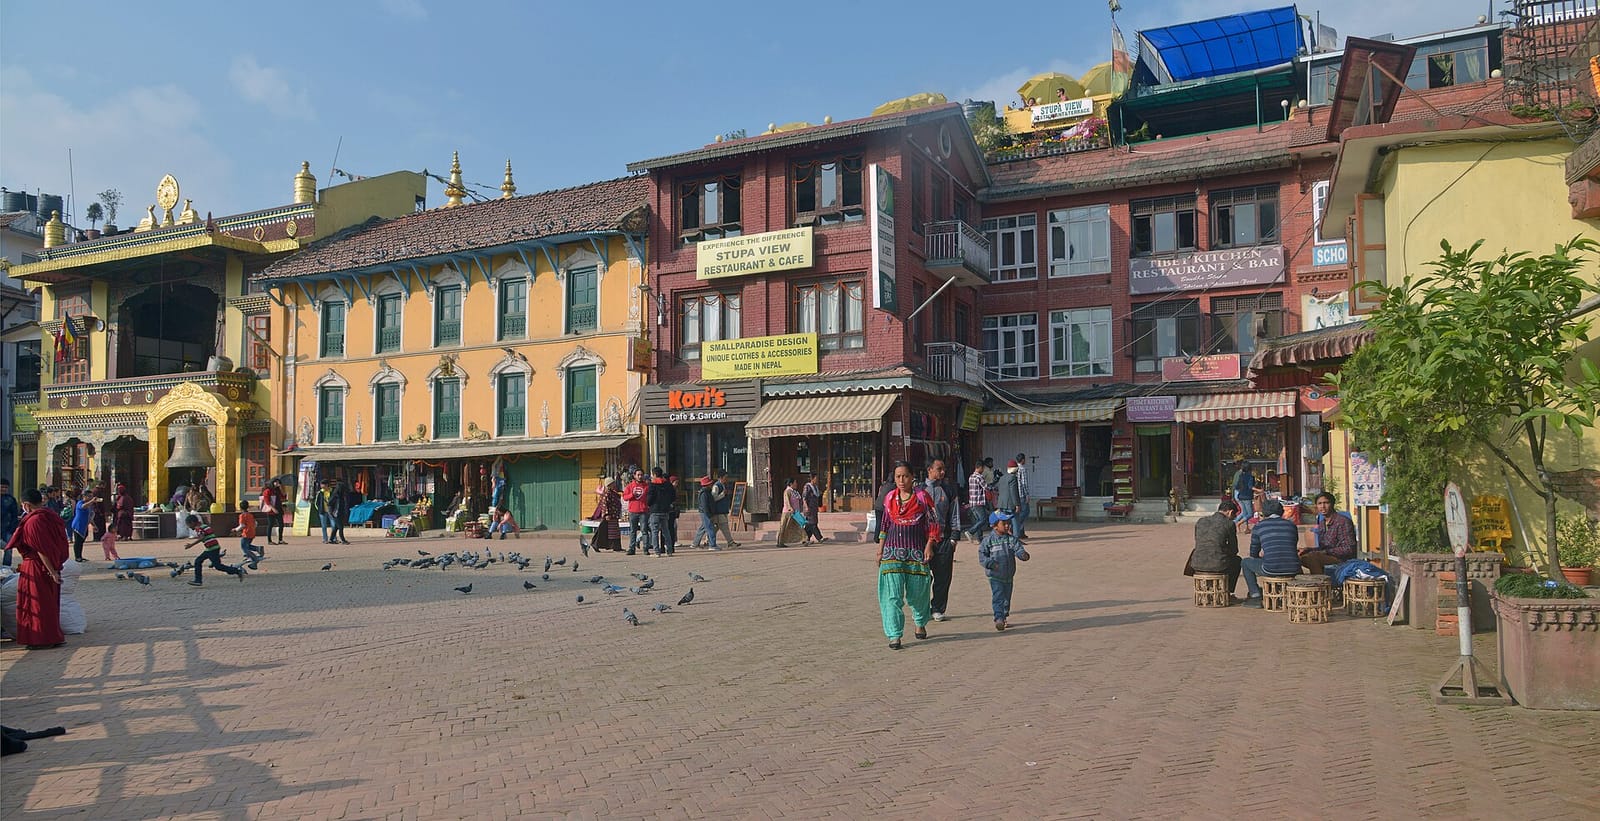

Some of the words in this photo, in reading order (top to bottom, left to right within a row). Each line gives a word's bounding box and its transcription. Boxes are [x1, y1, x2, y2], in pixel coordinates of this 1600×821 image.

[1040, 104, 1062, 115] STUPA
[1064, 101, 1083, 111] VIEW
[702, 239, 745, 251] EXPERIENCE
[747, 237, 761, 245] THE
[761, 231, 806, 242] DIFFERENCE
[716, 248, 755, 261] STUPA
[759, 243, 791, 255] VIEW
[1147, 256, 1188, 268] TIBET
[1193, 250, 1262, 264] KITCHEN
[1317, 247, 1347, 263] SCHO
[704, 260, 766, 275] RESTAURANT
[768, 258, 776, 267] &
[778, 254, 804, 266] CAFE
[1133, 262, 1228, 279] RESTAURANT
[1232, 262, 1245, 270] &
[1249, 258, 1280, 268] BAR
[709, 340, 775, 351] SMALLPARADISE
[776, 337, 808, 347] DESIGN
[706, 354, 729, 362] UNIQUE
[731, 351, 759, 361] CLOTHES
[767, 347, 812, 358] ACCESSORIES
[734, 363, 752, 371] MADE
[753, 362, 760, 370] IN
[761, 361, 782, 369] NEPAL
[668, 385, 727, 410] Kori's
[761, 425, 816, 437] GOLDEN
[820, 422, 858, 433] ARTS
